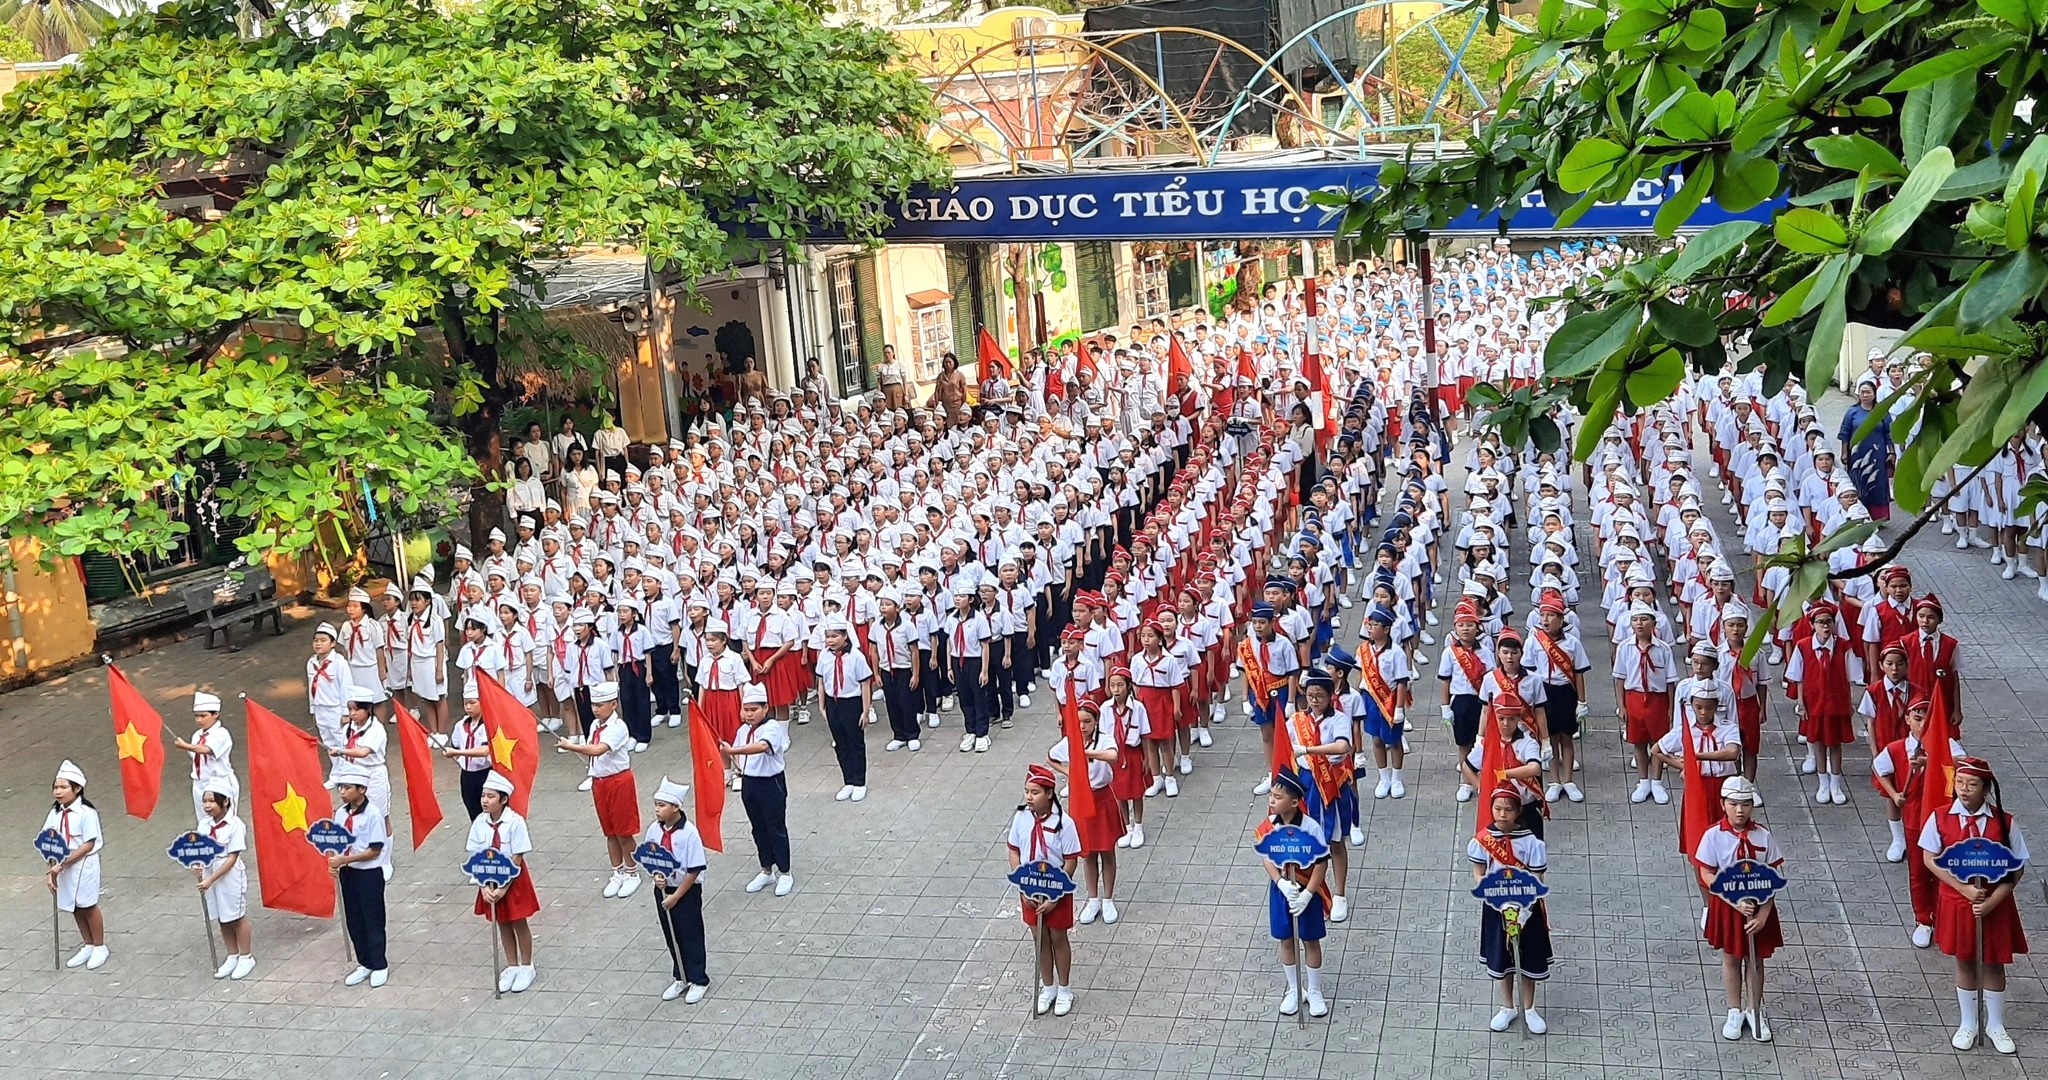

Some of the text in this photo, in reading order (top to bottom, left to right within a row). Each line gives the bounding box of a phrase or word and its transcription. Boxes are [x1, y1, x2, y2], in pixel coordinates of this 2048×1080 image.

[901, 186, 994, 222] GIÁO
[1008, 193, 1098, 226] DỤC
[1113, 176, 1224, 218] TIỂU
[1241, 185, 1350, 222] HỌC
[1270, 844, 1312, 855] NGÔ GIA TỰ
[1948, 857, 2009, 867] CÙ CHÍNH LAN
[1029, 878, 1037, 886] PA
[1738, 882, 1746, 891] A
[1508, 885, 1522, 896] VĂN
